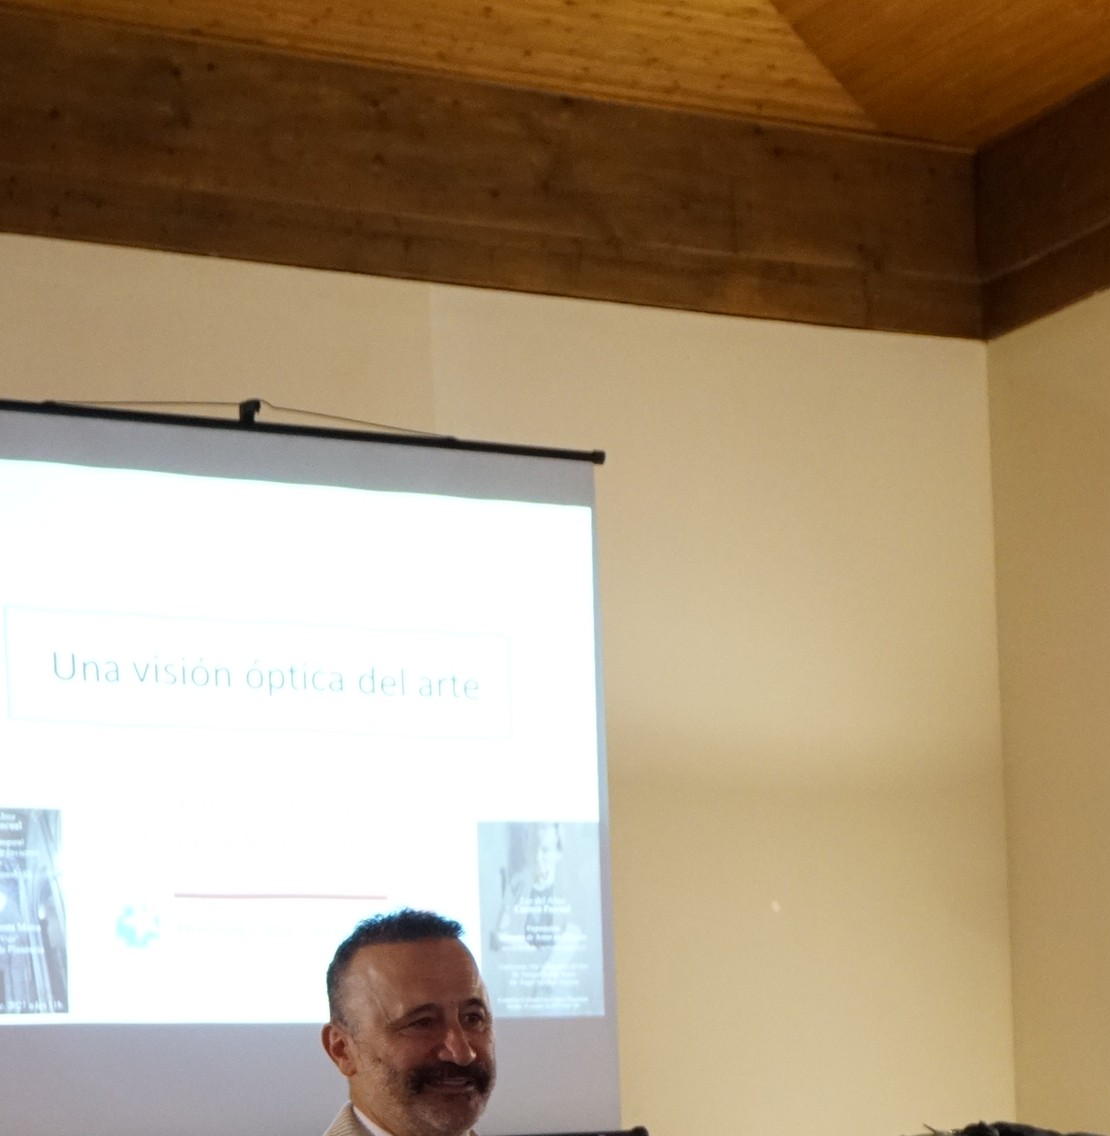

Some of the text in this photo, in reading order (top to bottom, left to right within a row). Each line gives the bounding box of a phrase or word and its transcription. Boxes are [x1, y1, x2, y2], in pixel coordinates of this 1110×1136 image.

[52, 651, 481, 700] Una visión óptica del arte
